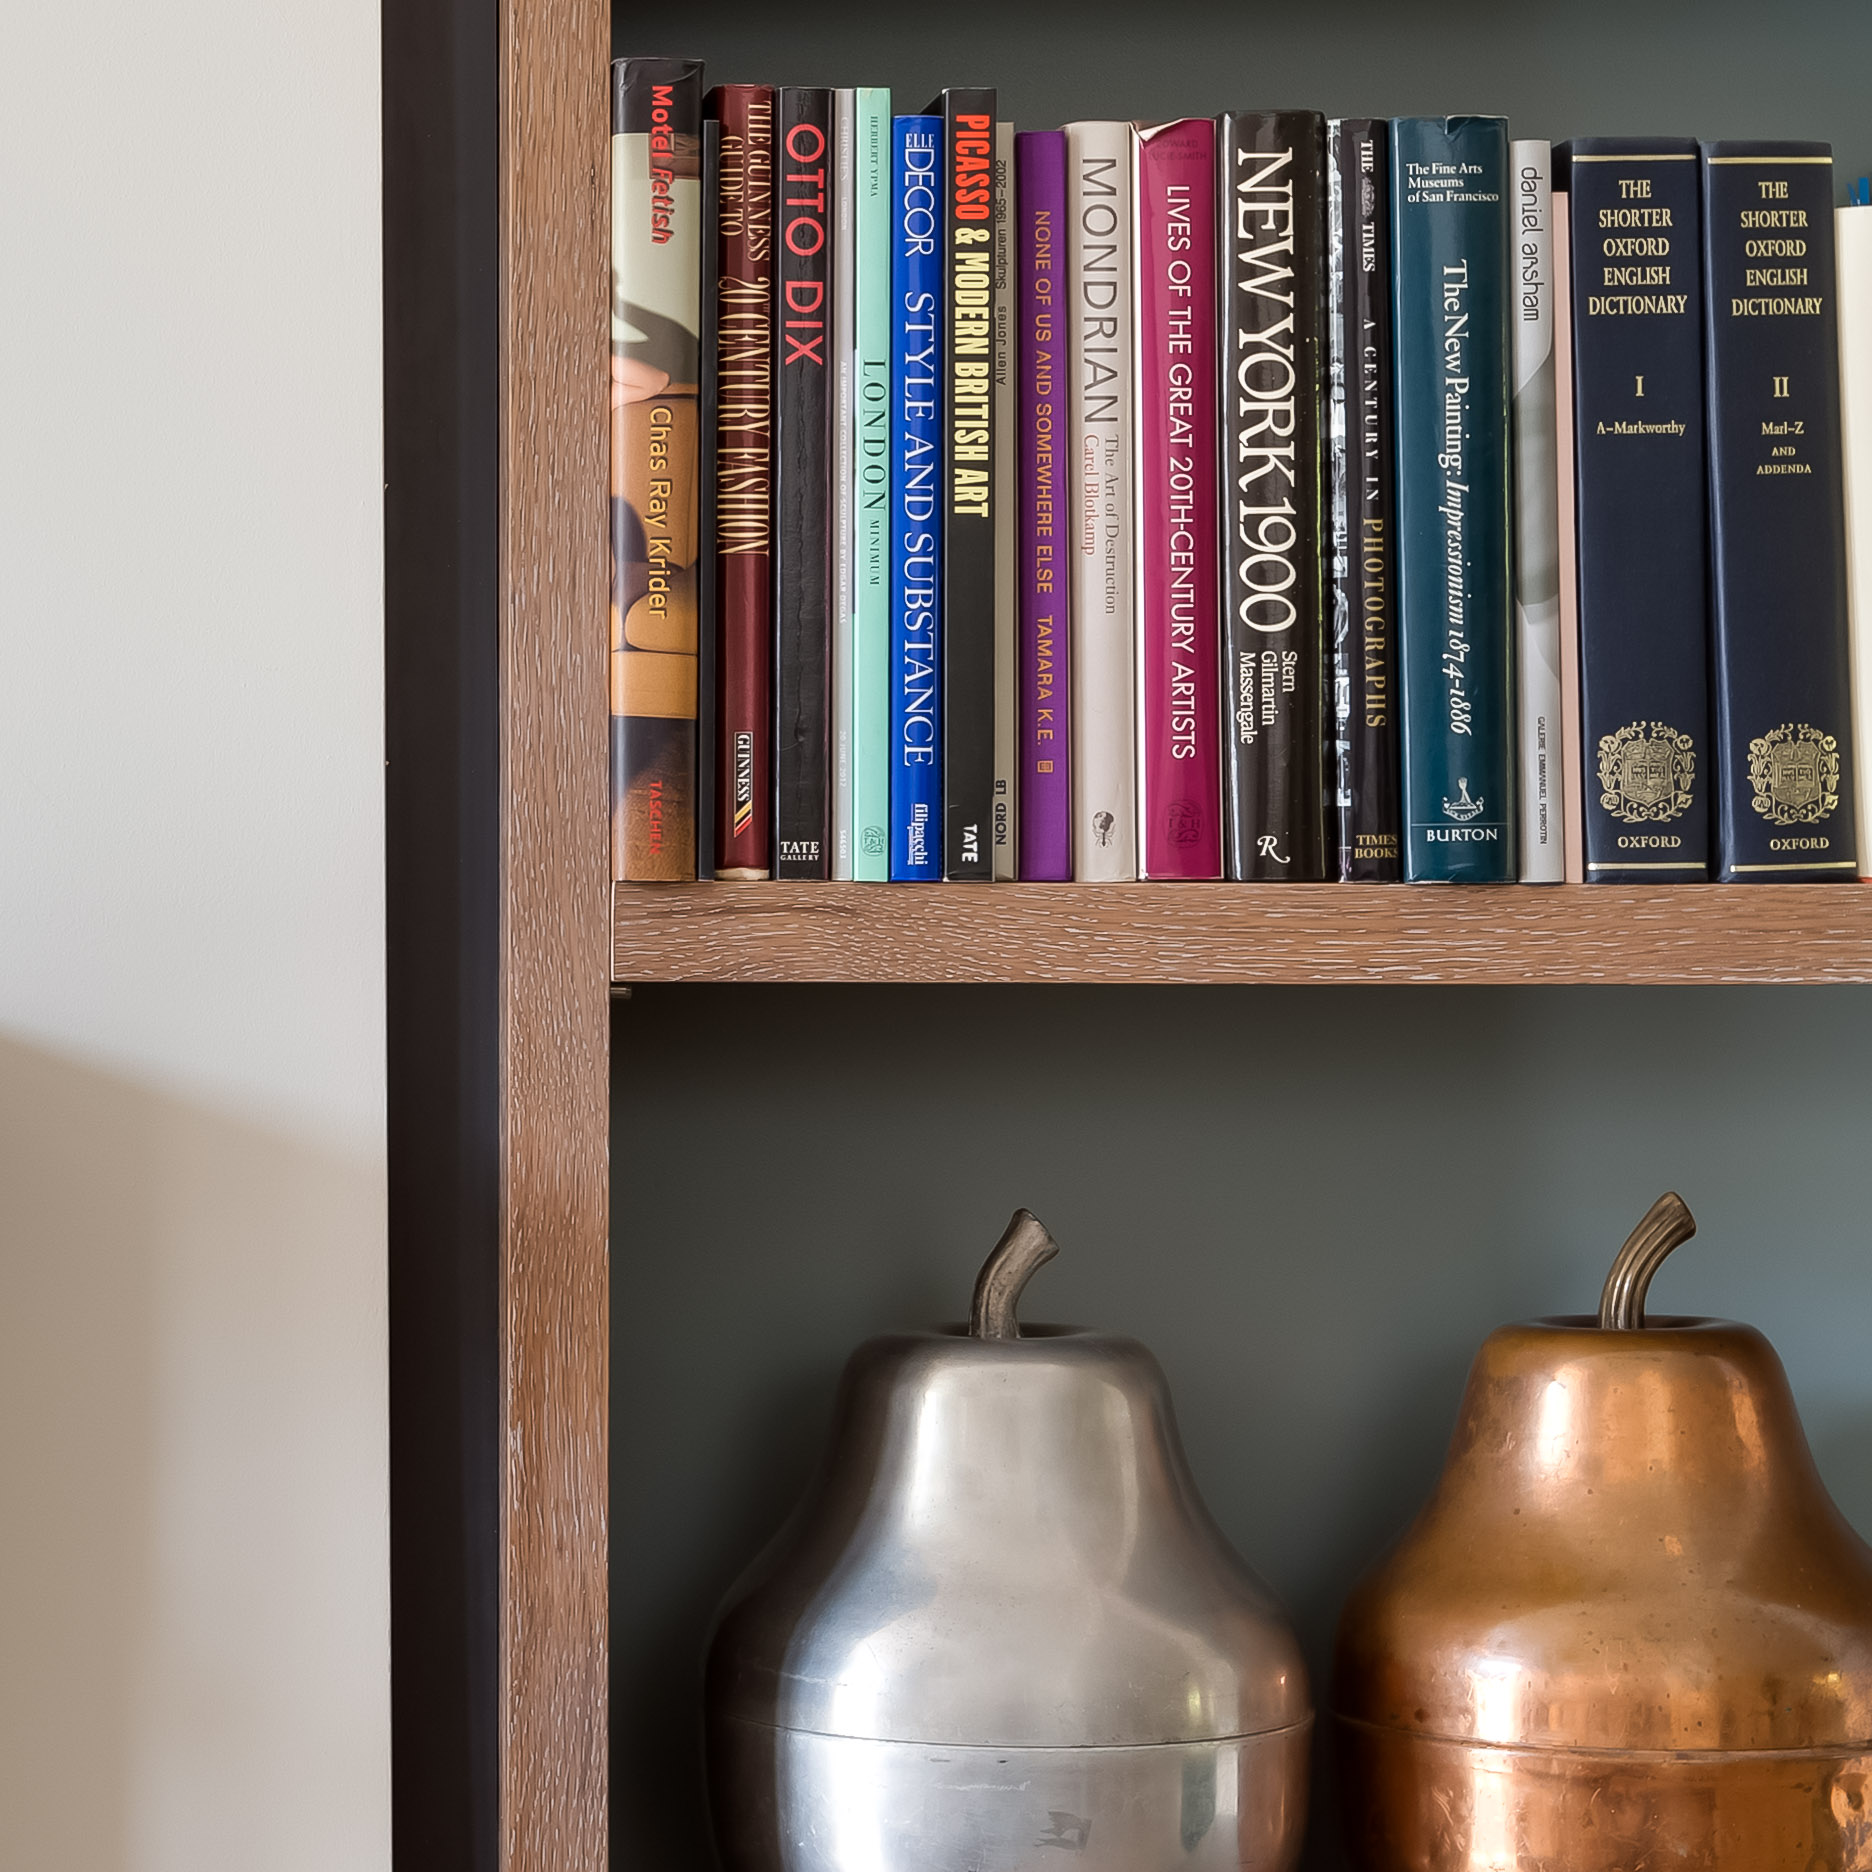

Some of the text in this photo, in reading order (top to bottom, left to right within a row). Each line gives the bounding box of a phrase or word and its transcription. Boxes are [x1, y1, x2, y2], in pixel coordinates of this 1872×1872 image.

[784, 123, 826, 366] OTTO DIX
[1599, 208, 1672, 227] SHORTER
[1604, 238, 1669, 257] OXFORD
[1604, 267, 1670, 286] ENGLISH
[1619, 180, 1651, 198] THE
[1081, 157, 1118, 424] MONDRIAN
[1588, 295, 1688, 315] DICTIONARY
[645, 85, 675, 855] Motel Fetish Chas Ray Krider TASCHEN
[862, 359, 887, 587] LONDON MINIMUM
[904, 150, 935, 767] DECOR STYLE AND SUBSTANCE
[1167, 185, 1196, 758] LIVES OF THE GREAT 20TH-CENTURY ARTISTS
[1237, 148, 1297, 631] NEW YORK 1900
[1635, 376, 1644, 396] I
[954, 114, 989, 862] PICASSO & MODERN BRITISH ART TATE
[1081, 434, 1101, 556] Carel Blotkamp
[1103, 434, 1121, 614] The Art of Destruction
[1438, 259, 1474, 735] The New Painting: Impressionism 1874-1886
[780, 841, 820, 854] TATE
[1617, 836, 1681, 848] OXFORD
